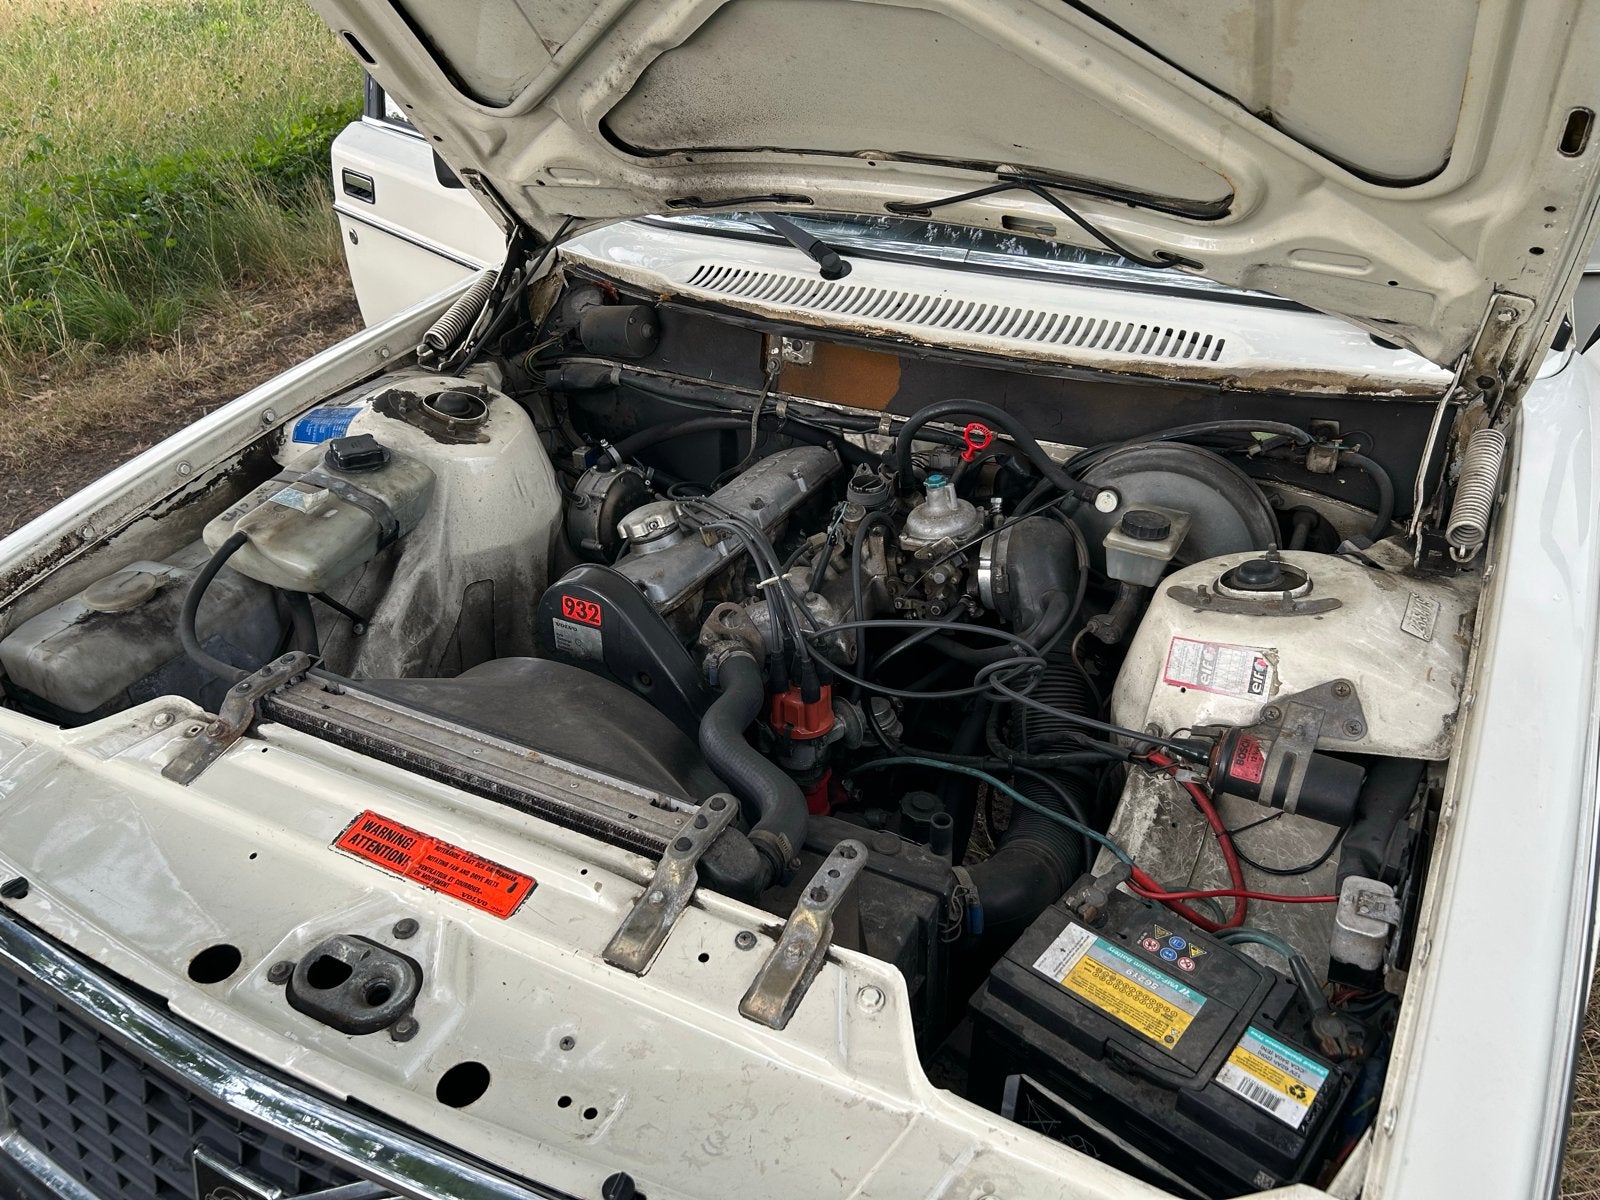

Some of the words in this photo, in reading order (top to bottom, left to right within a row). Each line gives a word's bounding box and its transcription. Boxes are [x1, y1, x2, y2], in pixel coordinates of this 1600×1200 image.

[565, 598, 600, 623] 932
[555, 622, 578, 631] VOLVO
[1200, 660, 1214, 685] elf
[1252, 671, 1265, 693] elf
[1236, 739, 1250, 766] BOSCH
[361, 819, 417, 850] WARNING!
[348, 833, 411, 866] ATTENTION!
[449, 863, 459, 871] FAN
[459, 868, 470, 876] AND
[461, 892, 488, 907] VOLVO
[1107, 946, 1133, 965] Battery
[1126, 968, 1160, 991] 56219
